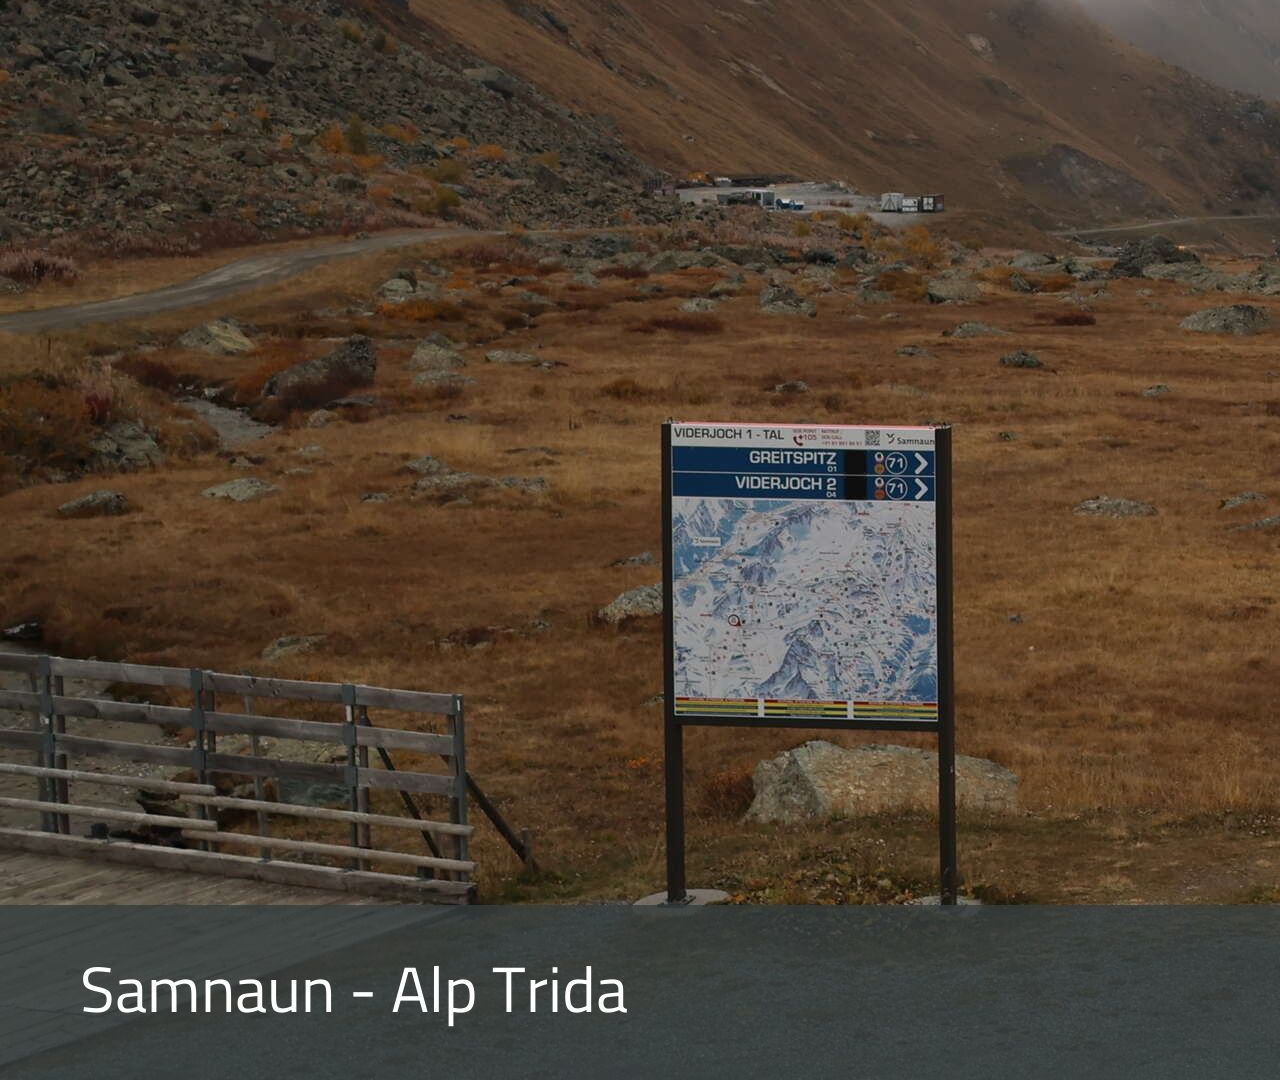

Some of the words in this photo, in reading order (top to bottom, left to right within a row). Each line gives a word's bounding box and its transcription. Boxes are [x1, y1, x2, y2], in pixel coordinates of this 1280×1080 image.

[674, 428, 742, 439] VIDERJOCH
[746, 429, 752, 439] 1
[763, 430, 784, 440] TAL
[897, 437, 935, 445] Samnaun
[749, 451, 837, 464] GREITSPITZ
[889, 458, 904, 468] 71
[735, 476, 822, 490] VIDERJOCH
[826, 478, 837, 490] 2
[889, 483, 904, 494] 71
